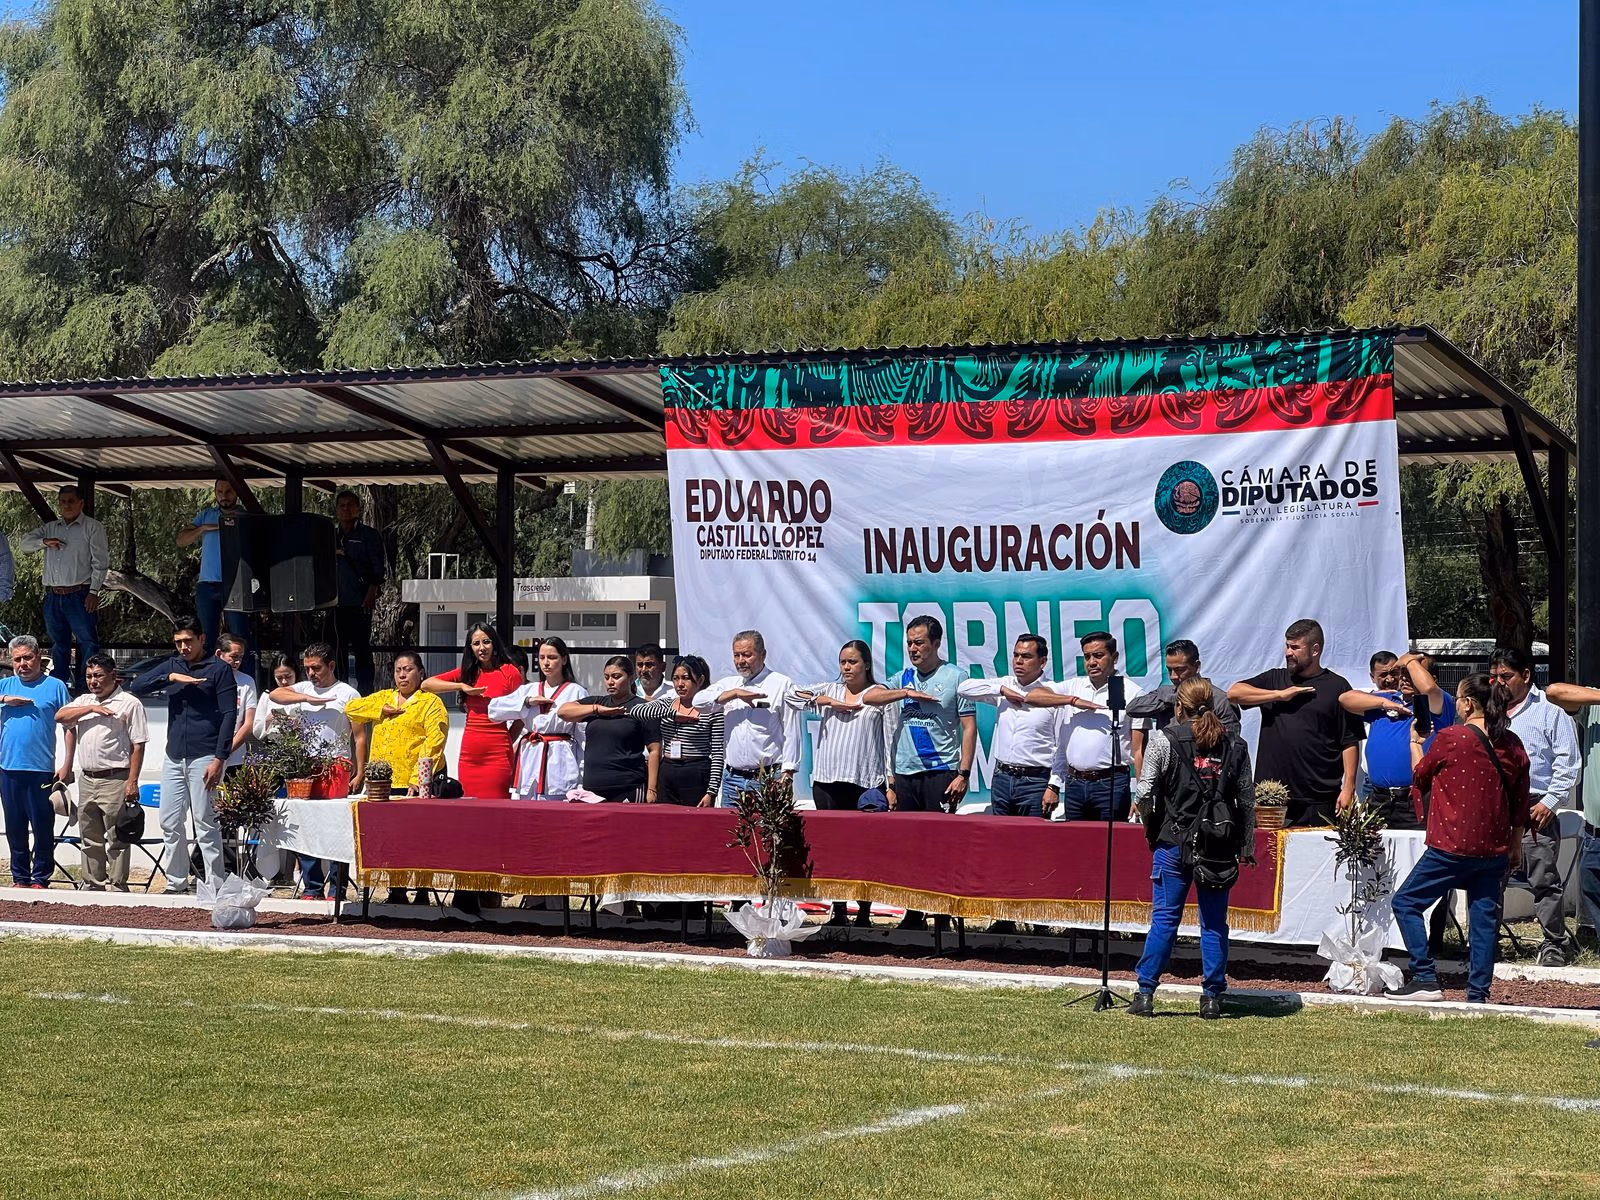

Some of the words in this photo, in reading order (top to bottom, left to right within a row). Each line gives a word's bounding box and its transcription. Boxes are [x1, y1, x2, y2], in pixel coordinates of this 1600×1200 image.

[1221, 464, 1328, 485] CÁMARA
[1345, 459, 1377, 477] DE
[685, 479, 832, 523] EDUARDO
[1221, 477, 1379, 507] DIPUTADOS
[1245, 508, 1271, 517] LXVI
[1276, 501, 1352, 514] LEGISLATURA
[696, 524, 770, 547] CASTILLO
[772, 520, 825, 548] LÓPEZ
[863, 509, 1140, 574] INAUGURACIÓN
[700, 549, 735, 560] DIPUTADO
[807, 552, 817, 563] 14
[517, 582, 551, 591] Trasciende
[437, 604, 445, 612] M
[638, 602, 646, 610] H
[857, 599, 1162, 686] TORNEO
